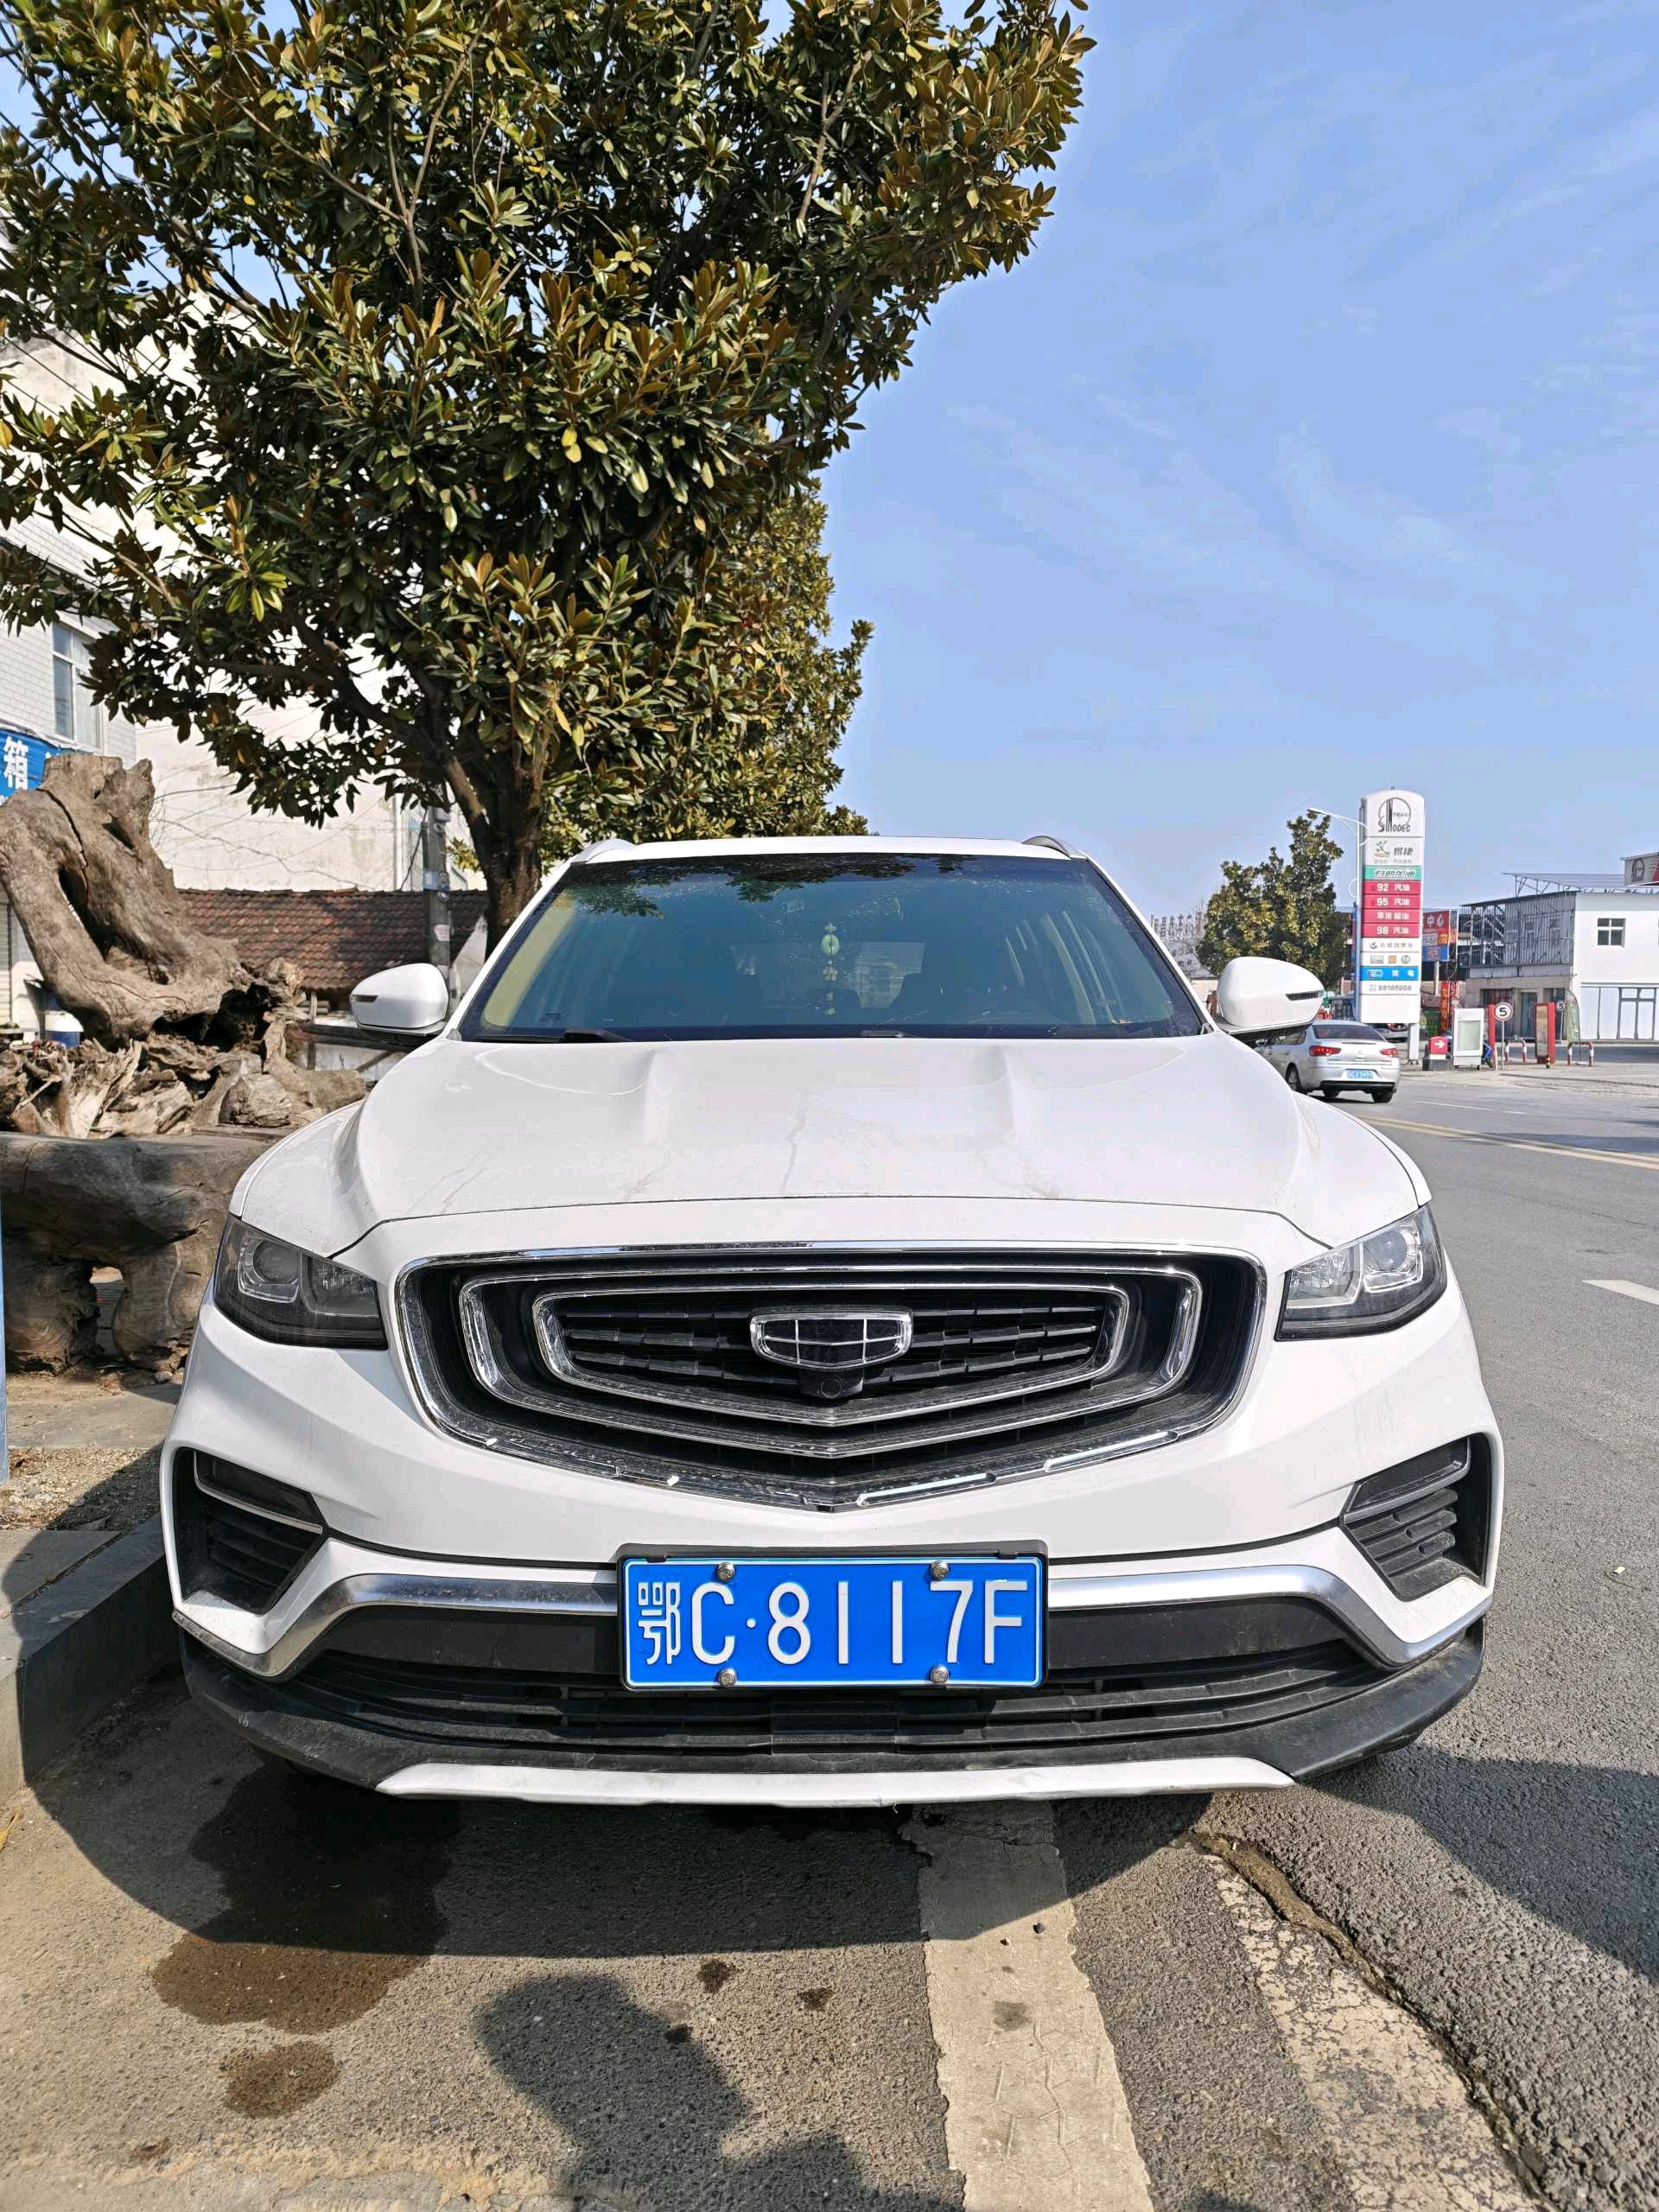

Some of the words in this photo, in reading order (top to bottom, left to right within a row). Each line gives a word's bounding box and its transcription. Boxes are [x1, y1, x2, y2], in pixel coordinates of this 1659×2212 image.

[1376, 883, 1389, 892] 92
[1376, 898, 1389, 906] 95
[1376, 925, 1389, 935] 98
[1499, 1007, 1508, 1016] 5
[637, 1580, 1028, 1665] 鄂C·8117F
